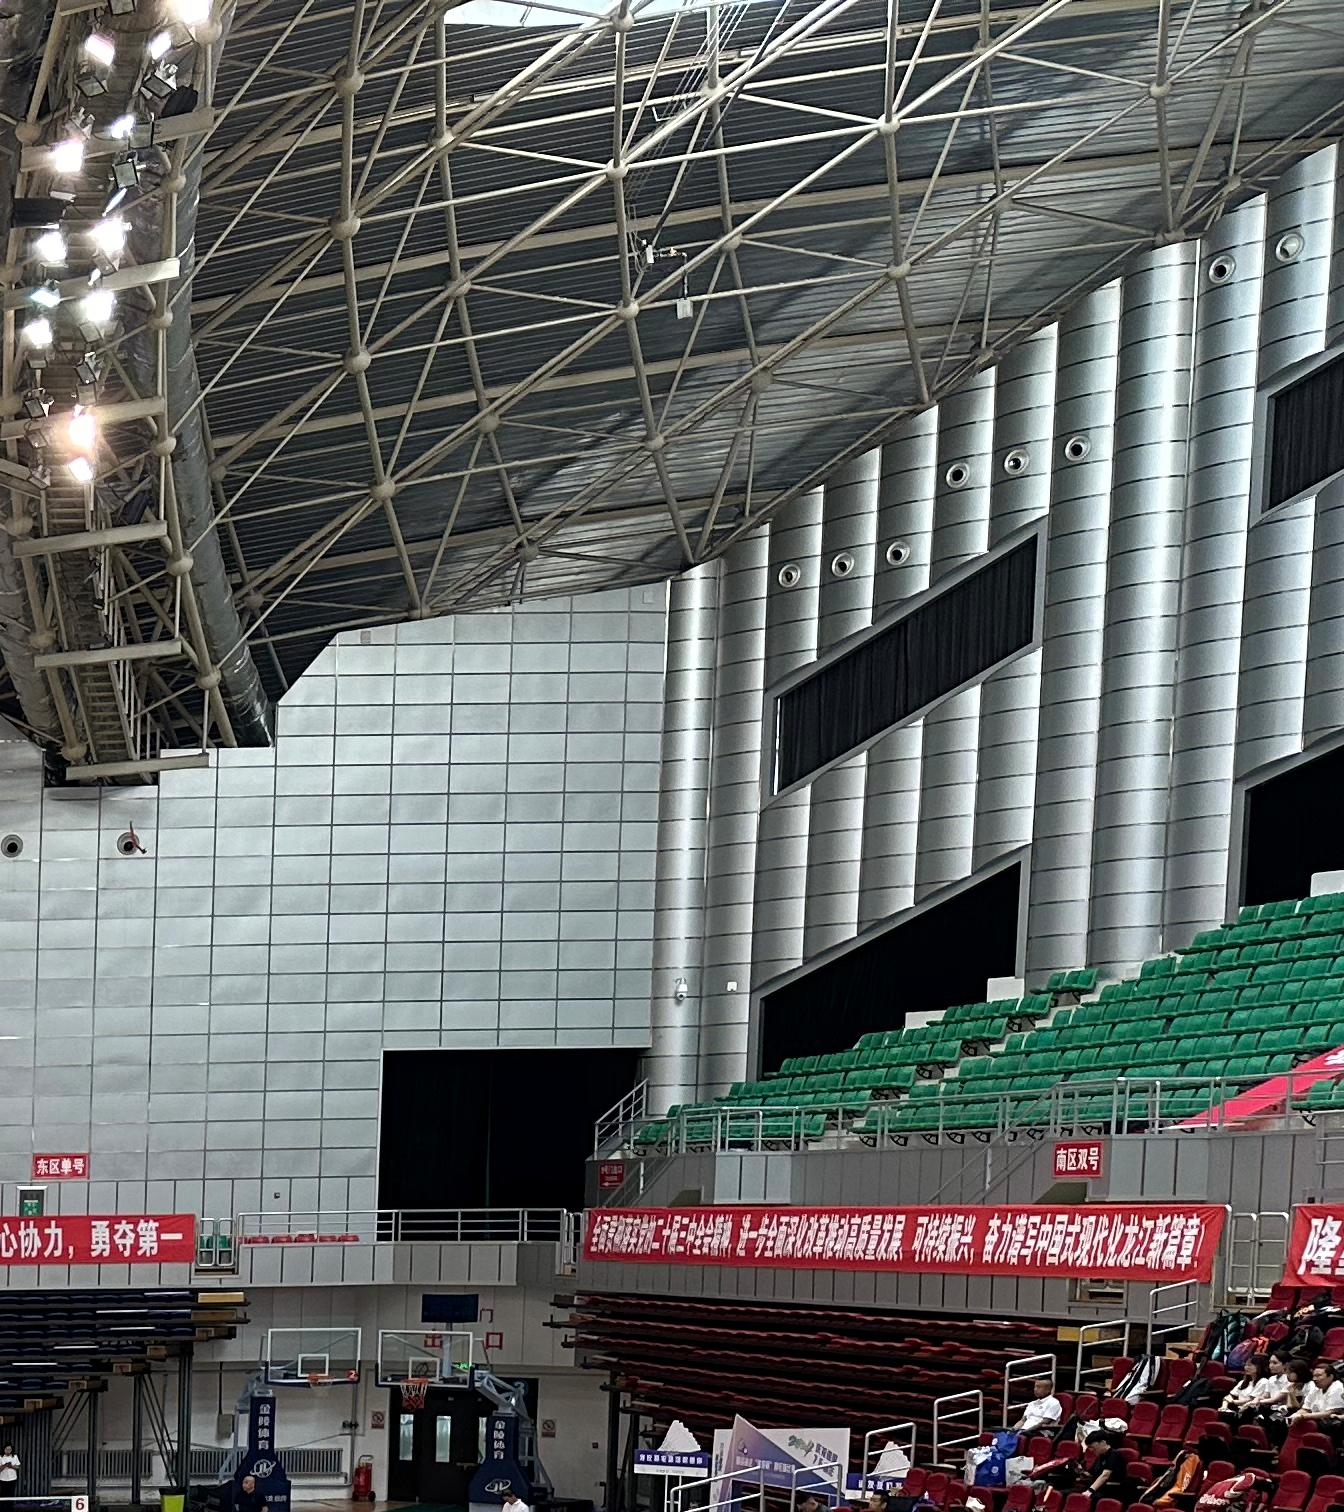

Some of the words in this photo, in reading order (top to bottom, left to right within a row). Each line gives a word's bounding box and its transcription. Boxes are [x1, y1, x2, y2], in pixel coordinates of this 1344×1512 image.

[36, 1157, 85, 1176] 东区单号
[1055, 1147, 1100, 1172] 南区双号
[1296, 1215, 1344, 1277] 隆
[75, 1497, 85, 1511] 6
